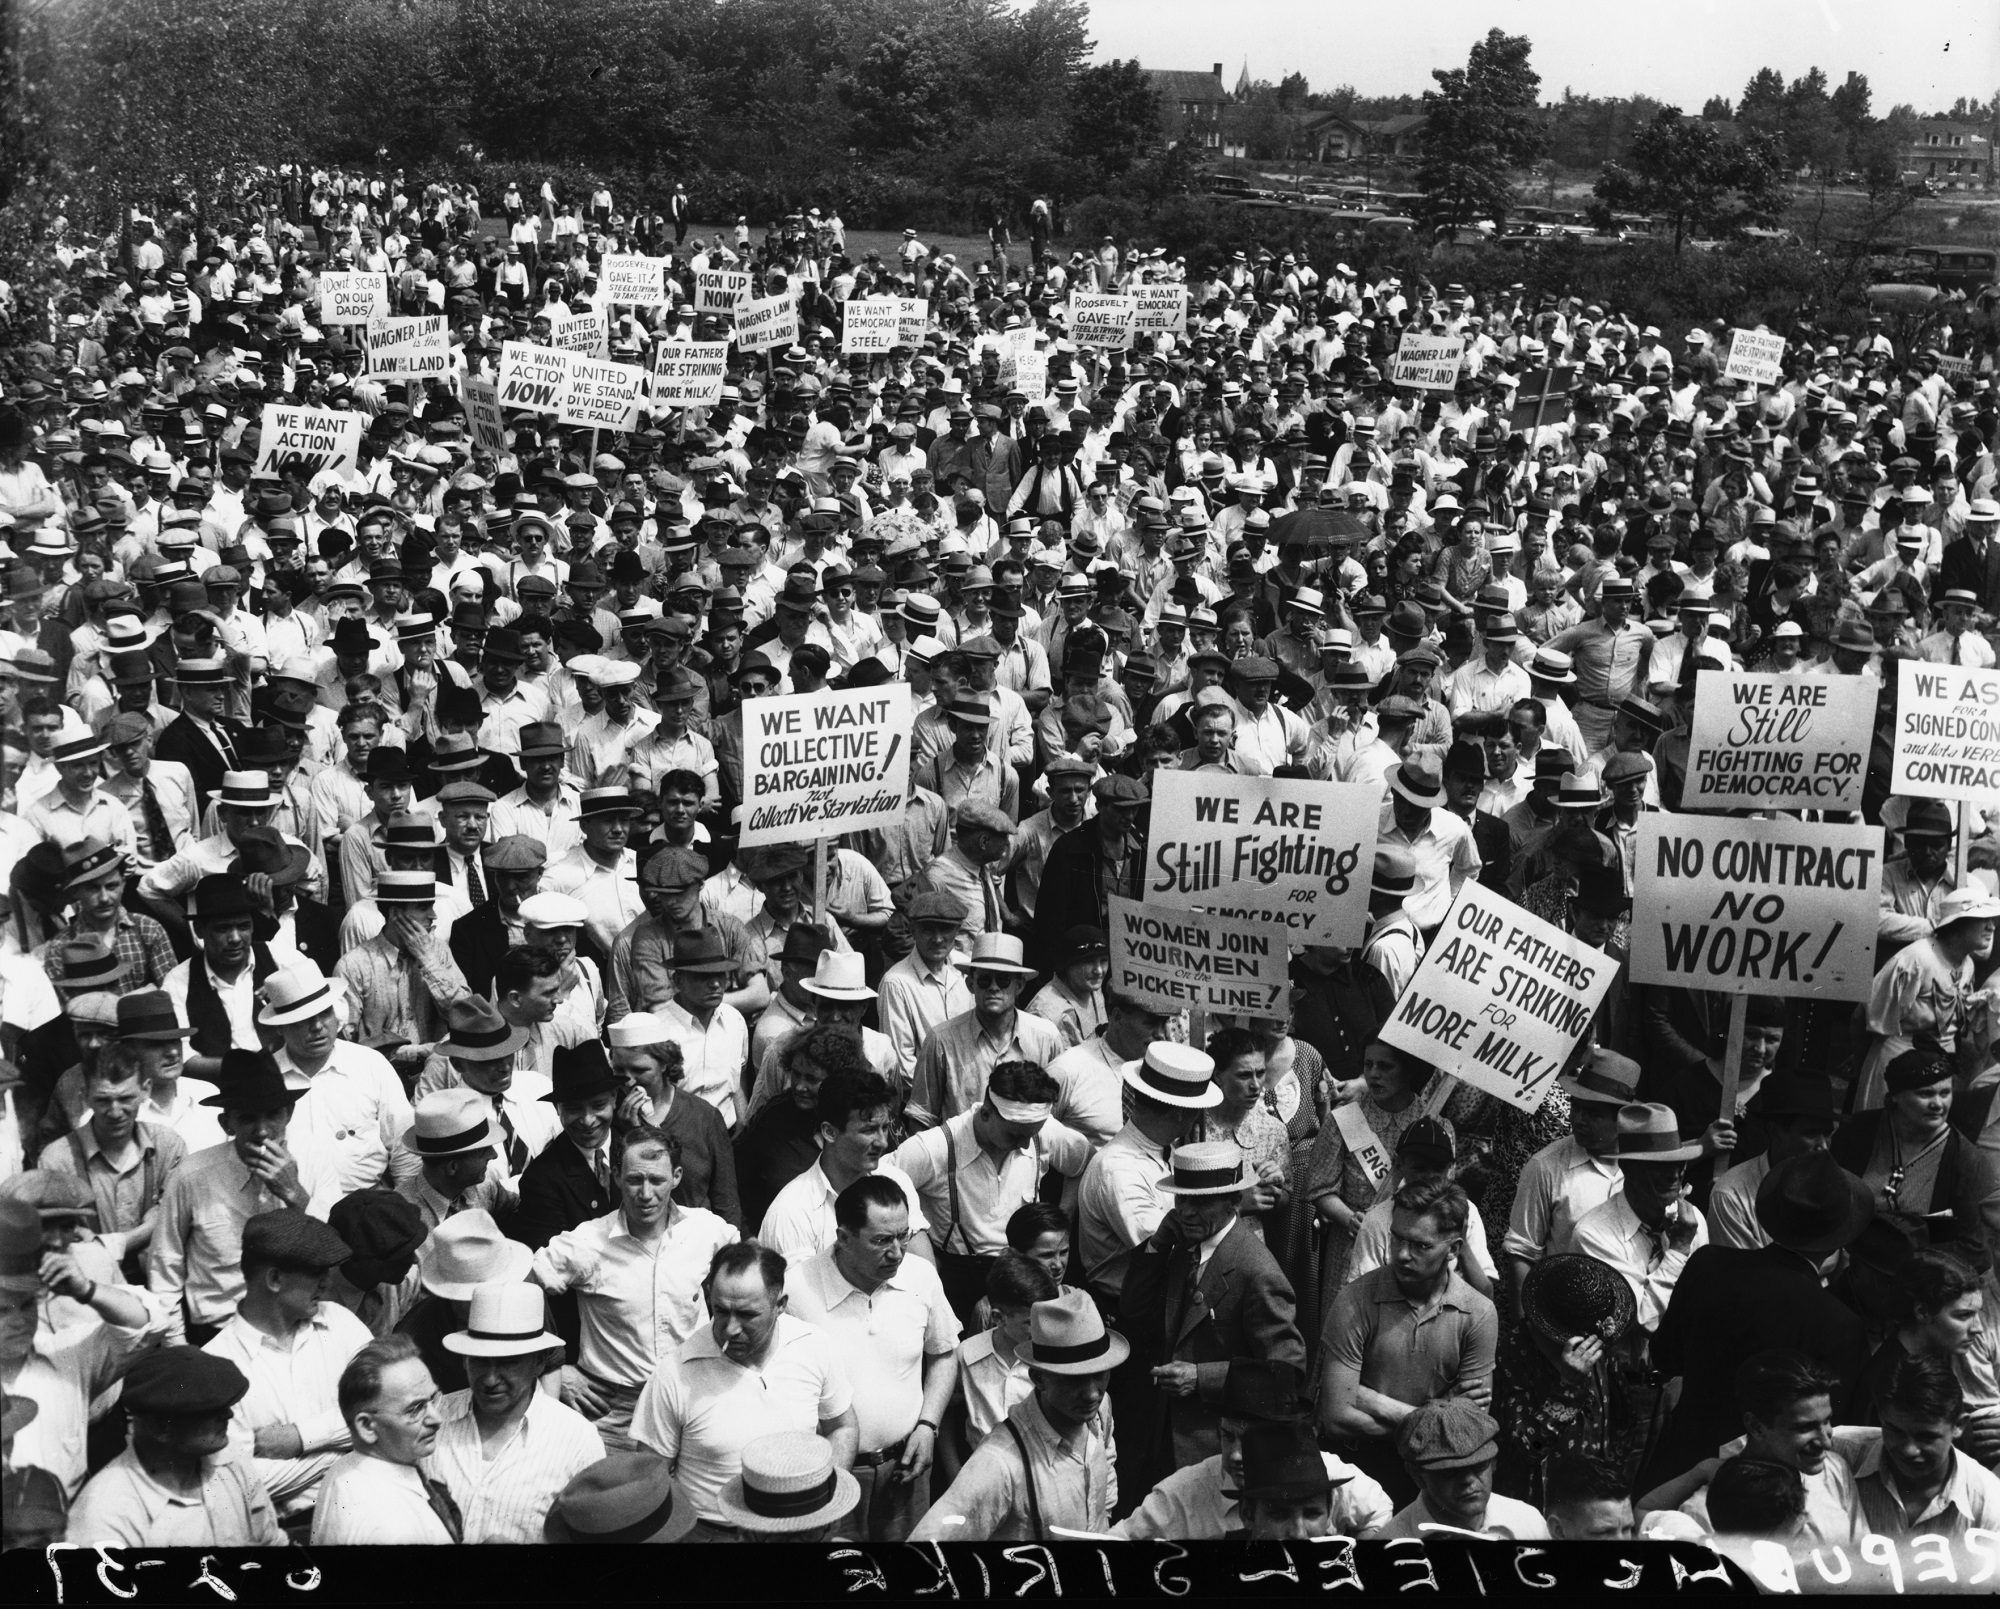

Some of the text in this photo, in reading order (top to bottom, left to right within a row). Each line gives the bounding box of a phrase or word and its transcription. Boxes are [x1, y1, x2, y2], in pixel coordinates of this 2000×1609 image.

[607, 258, 656, 272] ROOSEVELT
[355, 278, 381, 290] SCAB
[608, 284, 631, 292] STEEL
[698, 273, 746, 290] SIGN UP
[334, 292, 374, 304] ON OUR
[1074, 296, 1128, 308] ROOSEVELT
[1132, 289, 1180, 298] WE WANT
[336, 304, 374, 318] DADS!
[738, 300, 790, 331] WAGNER LAW
[848, 306, 892, 316] WE WANT
[1134, 312, 1180, 327] STEEL!
[372, 318, 388, 330] The
[558, 318, 596, 334] UNITED
[848, 318, 896, 328] DEMOCRACY
[1071, 324, 1125, 334] STEEL IS TRYING
[370, 316, 440, 350] WAGNER LAW
[412, 336, 440, 348] is the
[556, 336, 570, 346] WE
[739, 332, 758, 346] LAW
[769, 324, 796, 341] LAND!
[851, 336, 890, 347] STEEL!
[1075, 332, 1082, 340] TO
[1738, 334, 1782, 350] OUR FATHERS
[510, 349, 528, 362] WE
[560, 342, 594, 352] VIDED
[662, 348, 724, 359] OUR FATHERS
[1400, 347, 1460, 362] WAGNER LAW
[1733, 344, 1780, 362] ARE STRIKING
[373, 357, 398, 373] LAW
[410, 356, 444, 372] LAND
[656, 363, 722, 376] ARE STRIKING
[1729, 362, 1754, 376] MORE
[572, 365, 627, 384] UNITED
[1396, 365, 1420, 382] LAW
[1428, 368, 1454, 384] LAND
[466, 387, 494, 406] WE WANT
[572, 381, 639, 400] WE STAND!
[656, 384, 718, 398] MORE MILK!
[567, 395, 622, 412] DIVIDED
[474, 404, 496, 424] ACTION
[567, 406, 632, 424] WE FALL!
[276, 413, 348, 434] WE WANT
[276, 432, 336, 452] ACTION
[477, 422, 505, 452] NOW!
[1732, 683, 1828, 707] WE ARE
[1914, 673, 1948, 699] WE
[760, 700, 890, 736] WE WANT
[1952, 705, 1988, 716] FOR A
[1727, 705, 1814, 748] Still
[1904, 712, 1968, 738] SIGNED
[760, 730, 878, 768] COLLECTIVE
[1902, 742, 1929, 756] and
[754, 734, 902, 796] BARGAINING!
[1696, 749, 1862, 774] FIGHTING FOR
[1905, 760, 2000, 790] CONTRAC
[1699, 774, 1852, 797] DEMOCRACY
[805, 786, 836, 804] not
[748, 790, 902, 832] Collective Starvation
[1195, 796, 1322, 830] WE ARE
[1153, 834, 1362, 896] Still Fighting
[1656, 836, 1876, 890] NO CONTRACT
[1287, 889, 1318, 904] FOR
[1710, 890, 1785, 924] NO
[1192, 906, 1317, 930] EMOCRACY
[1124, 914, 1269, 956] WOMEN JOIN
[1457, 902, 1596, 992] OUR FATHERS
[1662, 920, 1845, 983] WORK!
[1174, 968, 1212, 984] on the
[1122, 970, 1282, 1010] PICKET LINE!
[1434, 936, 1591, 1038] ARE STRIKING
[1479, 1002, 1518, 1031] FOR
[1398, 991, 1558, 1098] MORE MILK!
